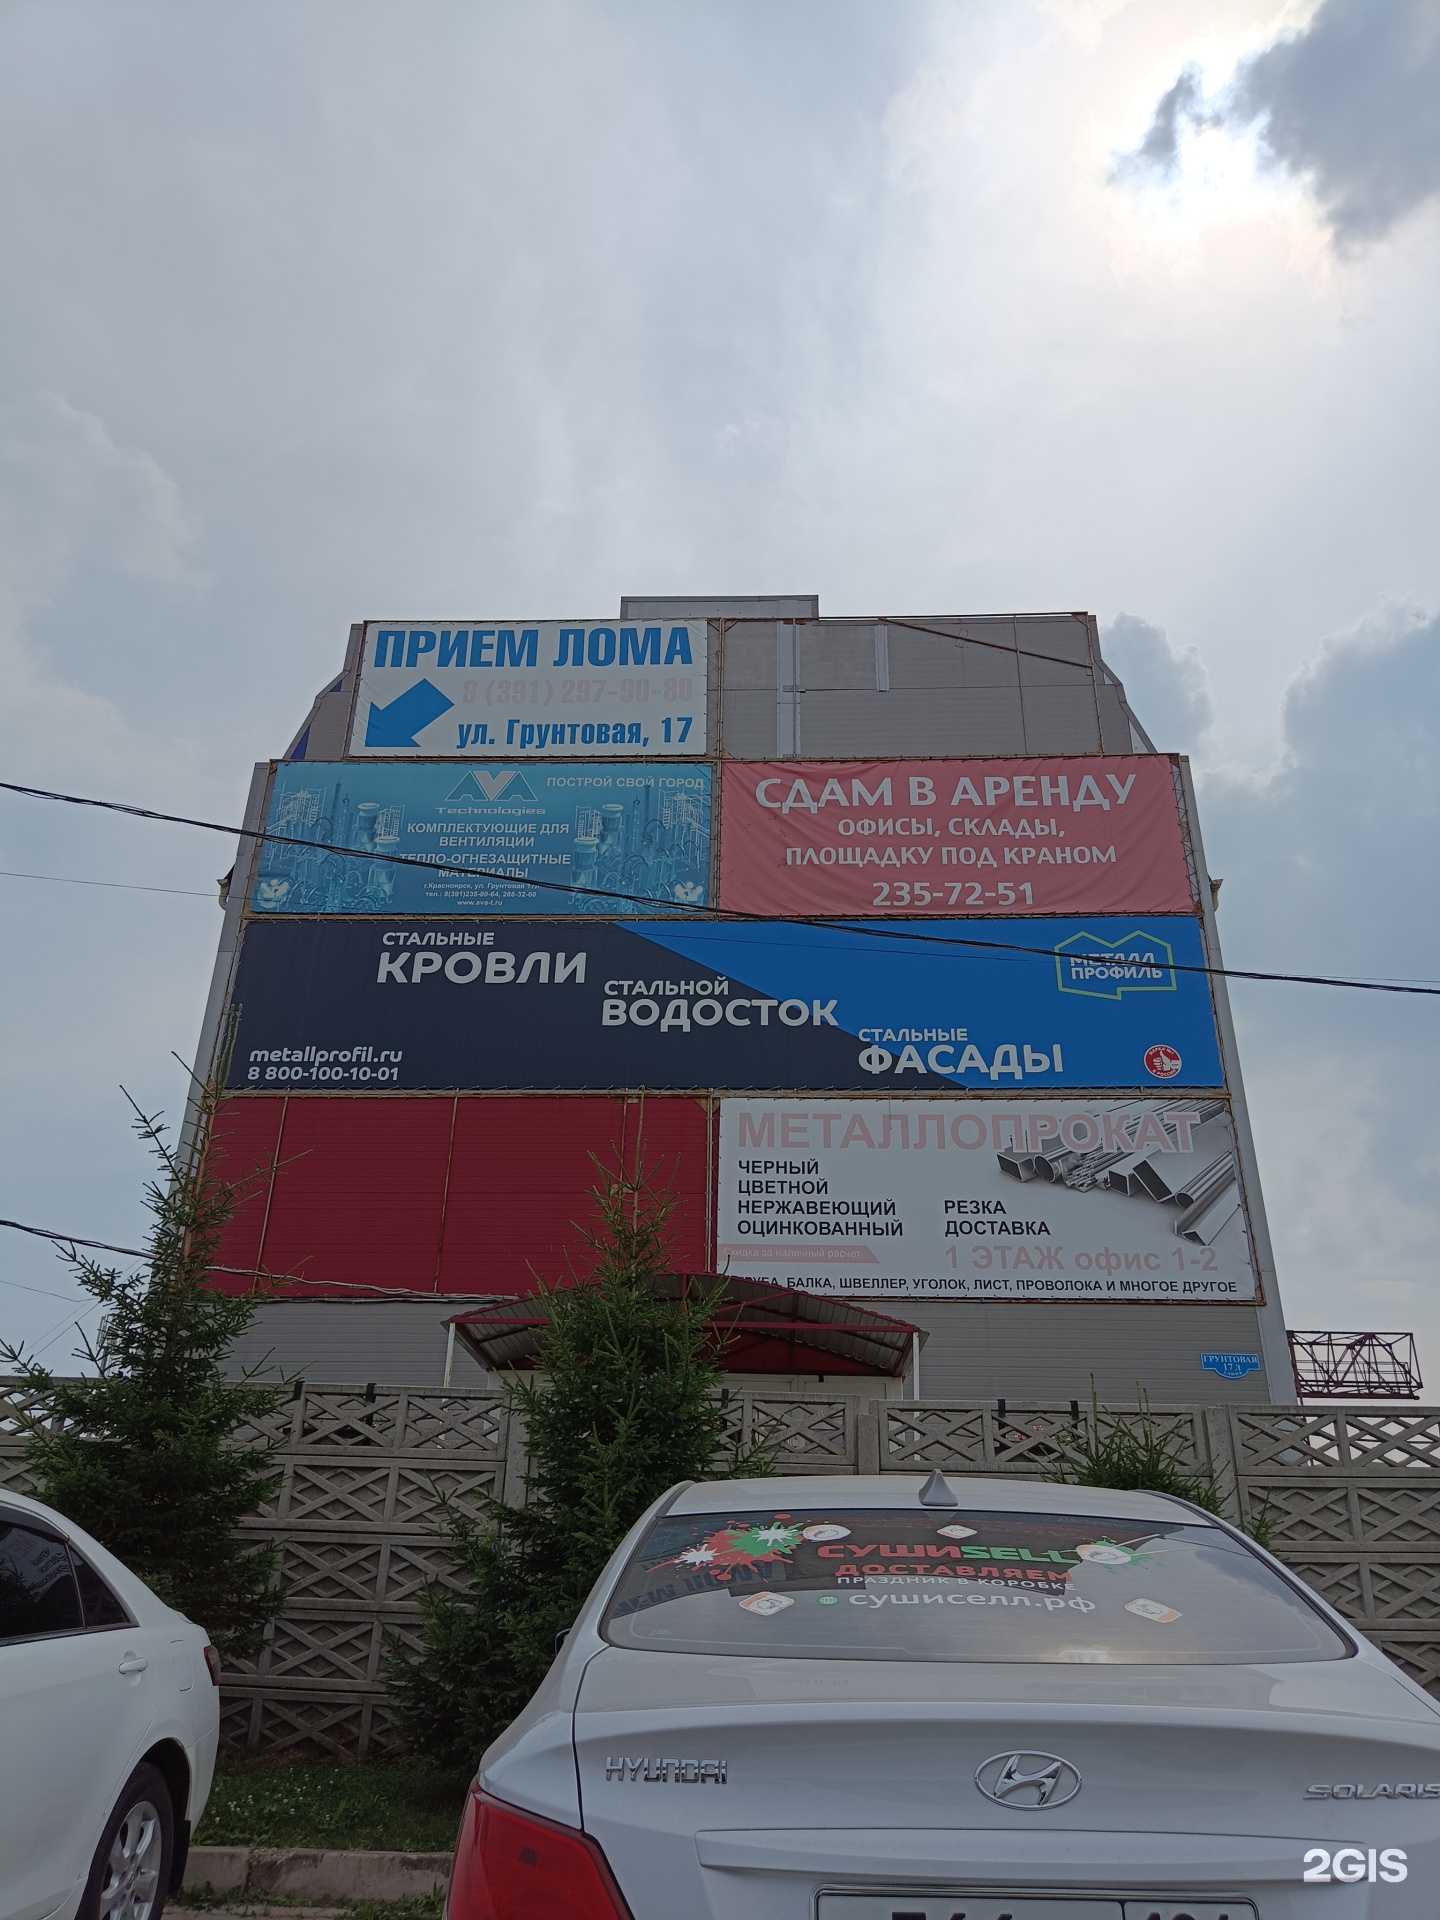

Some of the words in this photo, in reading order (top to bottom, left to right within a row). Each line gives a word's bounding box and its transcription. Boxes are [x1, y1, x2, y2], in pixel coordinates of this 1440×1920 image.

[373, 629, 539, 668] ПРИЕМ
[552, 627, 693, 667] ЛОМА
[456, 723, 495, 749] ул.
[506, 719, 649, 749] Грунтовая,
[661, 717, 693, 743] 17
[546, 776, 612, 787] ПОСТРОЙ
[616, 776, 655, 788] СВОЙ
[658, 777, 705, 790] ГОРОД
[755, 776, 893, 814] СДАМ
[909, 776, 936, 807] В
[950, 773, 1136, 812] АРЕНДУ
[435, 807, 546, 816] Technologies
[407, 822, 537, 834] КОМПЛЕКТУЮЩИЕ
[540, 823, 570, 834] ДЛЯ
[838, 817, 940, 838] ОФИСЫ,
[948, 817, 1065, 838] СКЛАДЫ,
[439, 836, 536, 847] ВЕНТИЛЯЦИИ
[786, 846, 934, 867] ПЛОЩАДКУ
[941, 846, 997, 868] ПОД
[1004, 845, 1117, 865] КРАНОМ
[872, 881, 1034, 906] 235-72-51
[382, 932, 495, 946] СТАЛЬНЫЕ
[376, 951, 587, 984] КРОВЛИ
[1071, 966, 1163, 980] ПРОФИЛЬ
[604, 977, 729, 996] СТАЛЬНОЙ
[601, 998, 839, 1032] ВОДОСТОК
[858, 1028, 968, 1042] СТАЛЬНЫЕ
[249, 1046, 403, 1065] metallprofil.ru
[858, 1044, 1063, 1080] ФАСАДЫ
[247, 1067, 260, 1080] 8
[265, 1066, 399, 1081] 800-100-10-01
[738, 1112, 1199, 1152] МЕТАЛЛОПРОКАТ
[738, 1157, 819, 1175] ЧЕРНЫЙ
[738, 1177, 829, 1198] ЦВЕТНОЙ
[738, 1197, 897, 1219] НЕРЖАВЕЮЩИЙ
[944, 1200, 1007, 1216] РЕЗКА
[737, 1217, 903, 1239] ОЦИНКОВАННЫЙ
[945, 1219, 1051, 1238] ДОСТАВКА
[945, 1246, 959, 1268] 1
[972, 1246, 1063, 1270] ЭТАЖ
[1074, 1246, 1161, 1275] офис
[1171, 1247, 1218, 1271] 1-2
[787, 1277, 836, 1290] БАЛКА,
[839, 1278, 909, 1291] ШВЕЛЛЕР,
[913, 1278, 970, 1291] УГОЛОК,
[974, 1279, 1012, 1292] ЛИСТ,
[1016, 1279, 1101, 1292] ПРОВОЛОКА
[1106, 1280, 1116, 1292] И
[1120, 1280, 1179, 1292] МНОГОЕ
[1182, 1281, 1237, 1293] ДРУГОЕ
[835, 1564, 1074, 1582] ДОСТАВЛЯЕМ
[837, 1575, 948, 1585] ПРАЗДНИК
[978, 1577, 1078, 1592] КОРОБКЕ
[848, 1593, 1097, 1614] сушиселл.рф
[604, 1756, 728, 1785] HYUNDAI
[1302, 1783, 1440, 1801] SOLARIS
